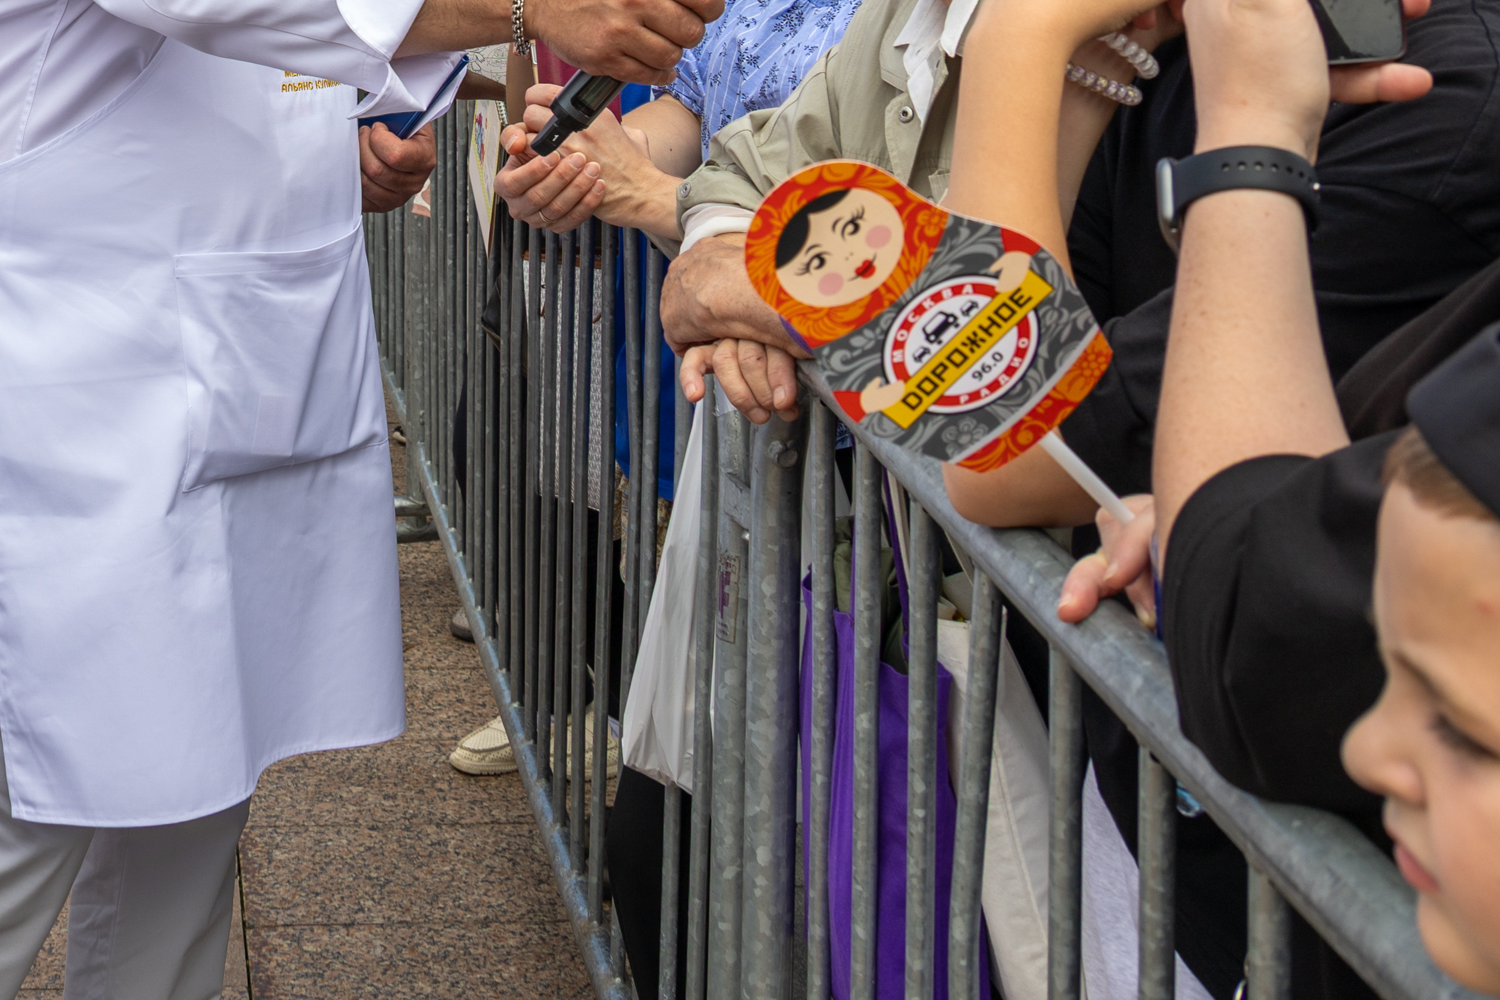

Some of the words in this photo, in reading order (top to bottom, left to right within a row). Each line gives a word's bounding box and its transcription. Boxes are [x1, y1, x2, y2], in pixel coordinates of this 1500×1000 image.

[281, 81, 313, 93] АЛЬЯНС
[892, 284, 974, 363] МОСКВА
[901, 287, 1032, 411] ДОРОЖНОЕ
[959, 338, 1029, 405] РАДИО
[971, 351, 1004, 382] 96.0
